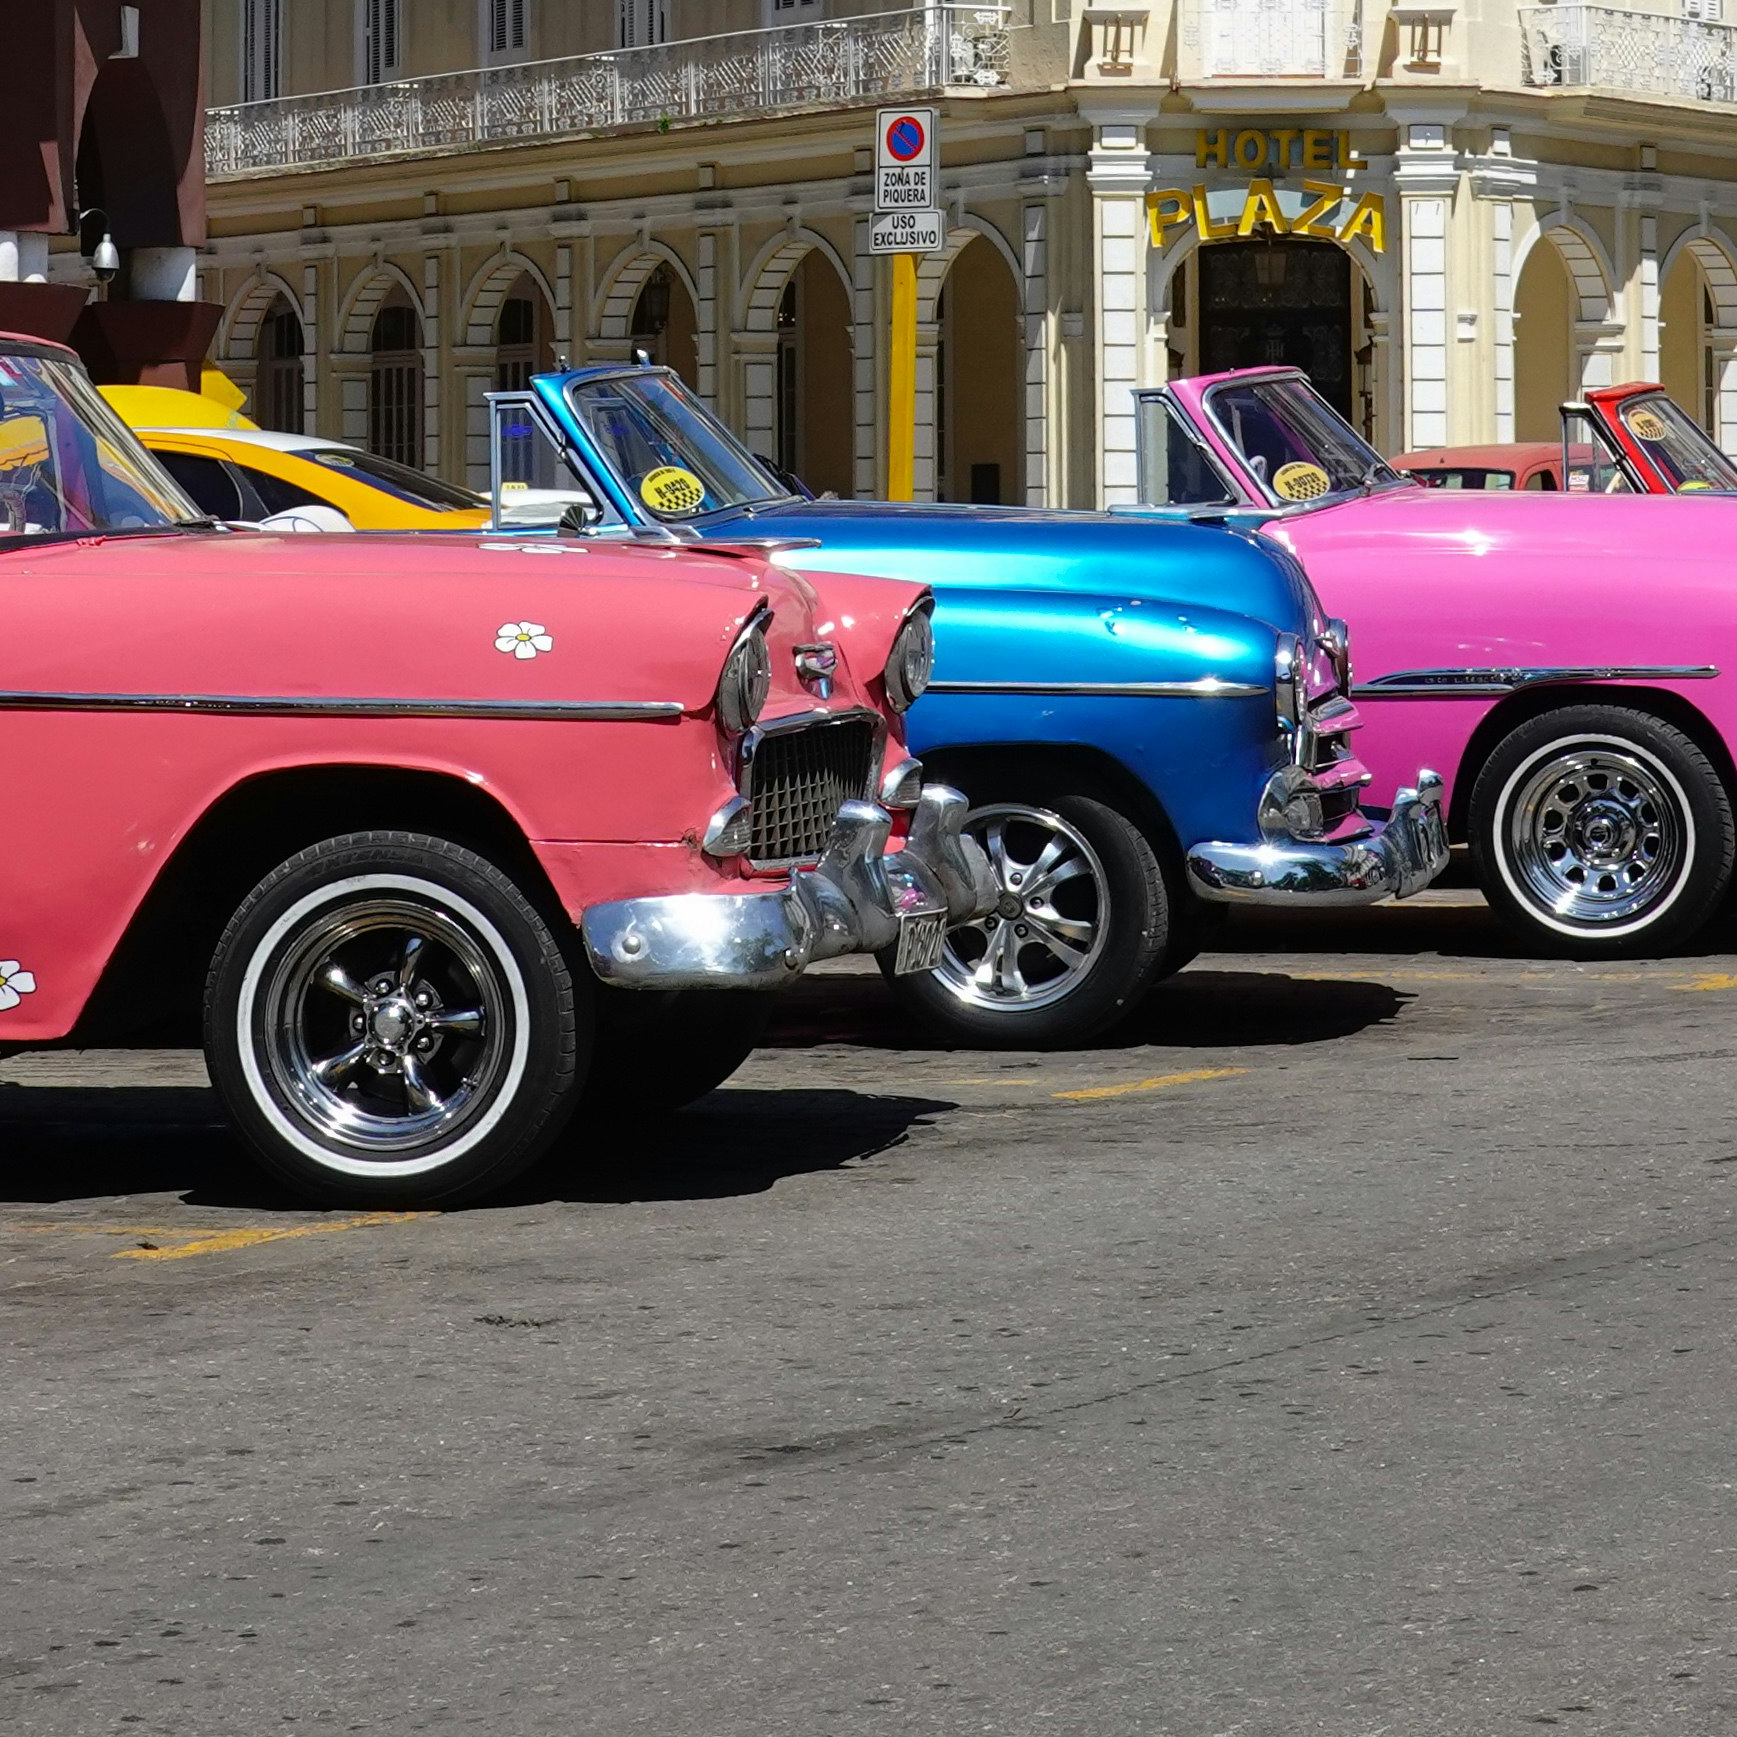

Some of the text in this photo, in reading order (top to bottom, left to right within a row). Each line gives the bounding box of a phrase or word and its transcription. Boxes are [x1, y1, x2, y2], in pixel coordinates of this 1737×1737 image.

[1196, 128, 1368, 170] HOTEL
[884, 171, 926, 187] ZONA DE
[883, 187, 926, 203] PIQUERA
[891, 215, 916, 229] USO
[1146, 178, 1387, 254] PLAZA
[873, 230, 937, 246] EXCLUSIVO
